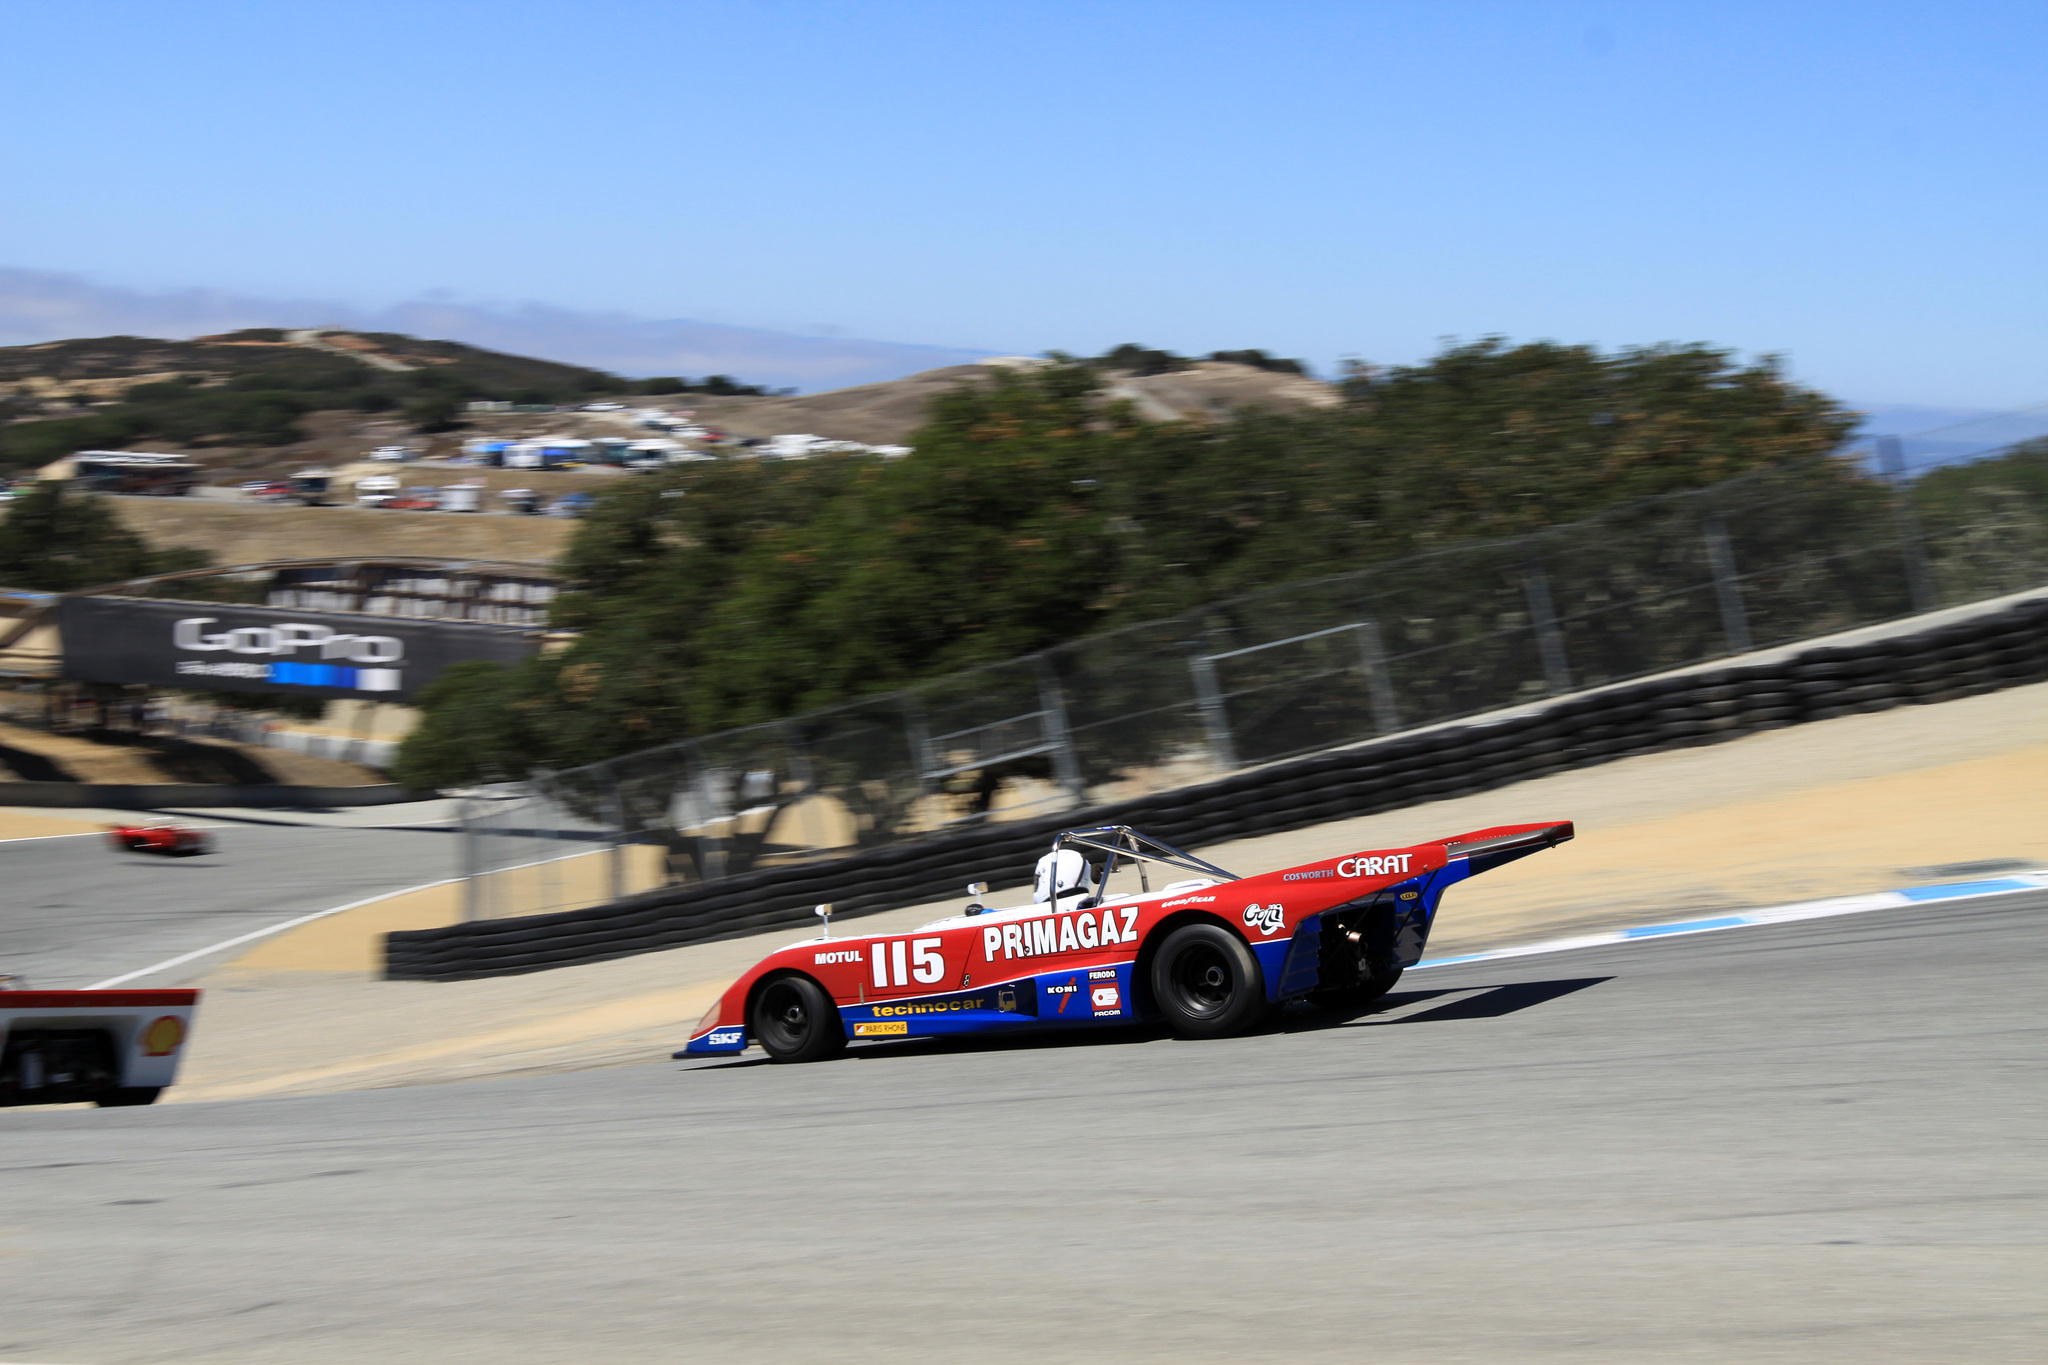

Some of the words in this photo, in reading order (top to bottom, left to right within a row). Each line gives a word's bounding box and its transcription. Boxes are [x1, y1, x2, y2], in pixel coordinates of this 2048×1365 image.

[173, 617, 404, 663] GoPro
[1283, 869, 1334, 881] COSWORTH
[1336, 853, 1413, 878] CARAT
[1161, 895, 1216, 908] GOODYEAR
[983, 906, 1139, 962] PRIMAGAZ
[815, 951, 863, 964] MOTUL
[871, 937, 945, 988] 115
[1089, 969, 1116, 980] FERODO
[1047, 985, 1078, 995] KONI
[872, 998, 984, 1017] technocar
[1093, 1009, 1121, 1017] FACOM
[866, 1024, 882, 1033] PARIS
[884, 1023, 906, 1032] RHONE
[709, 1032, 742, 1045] SKF
